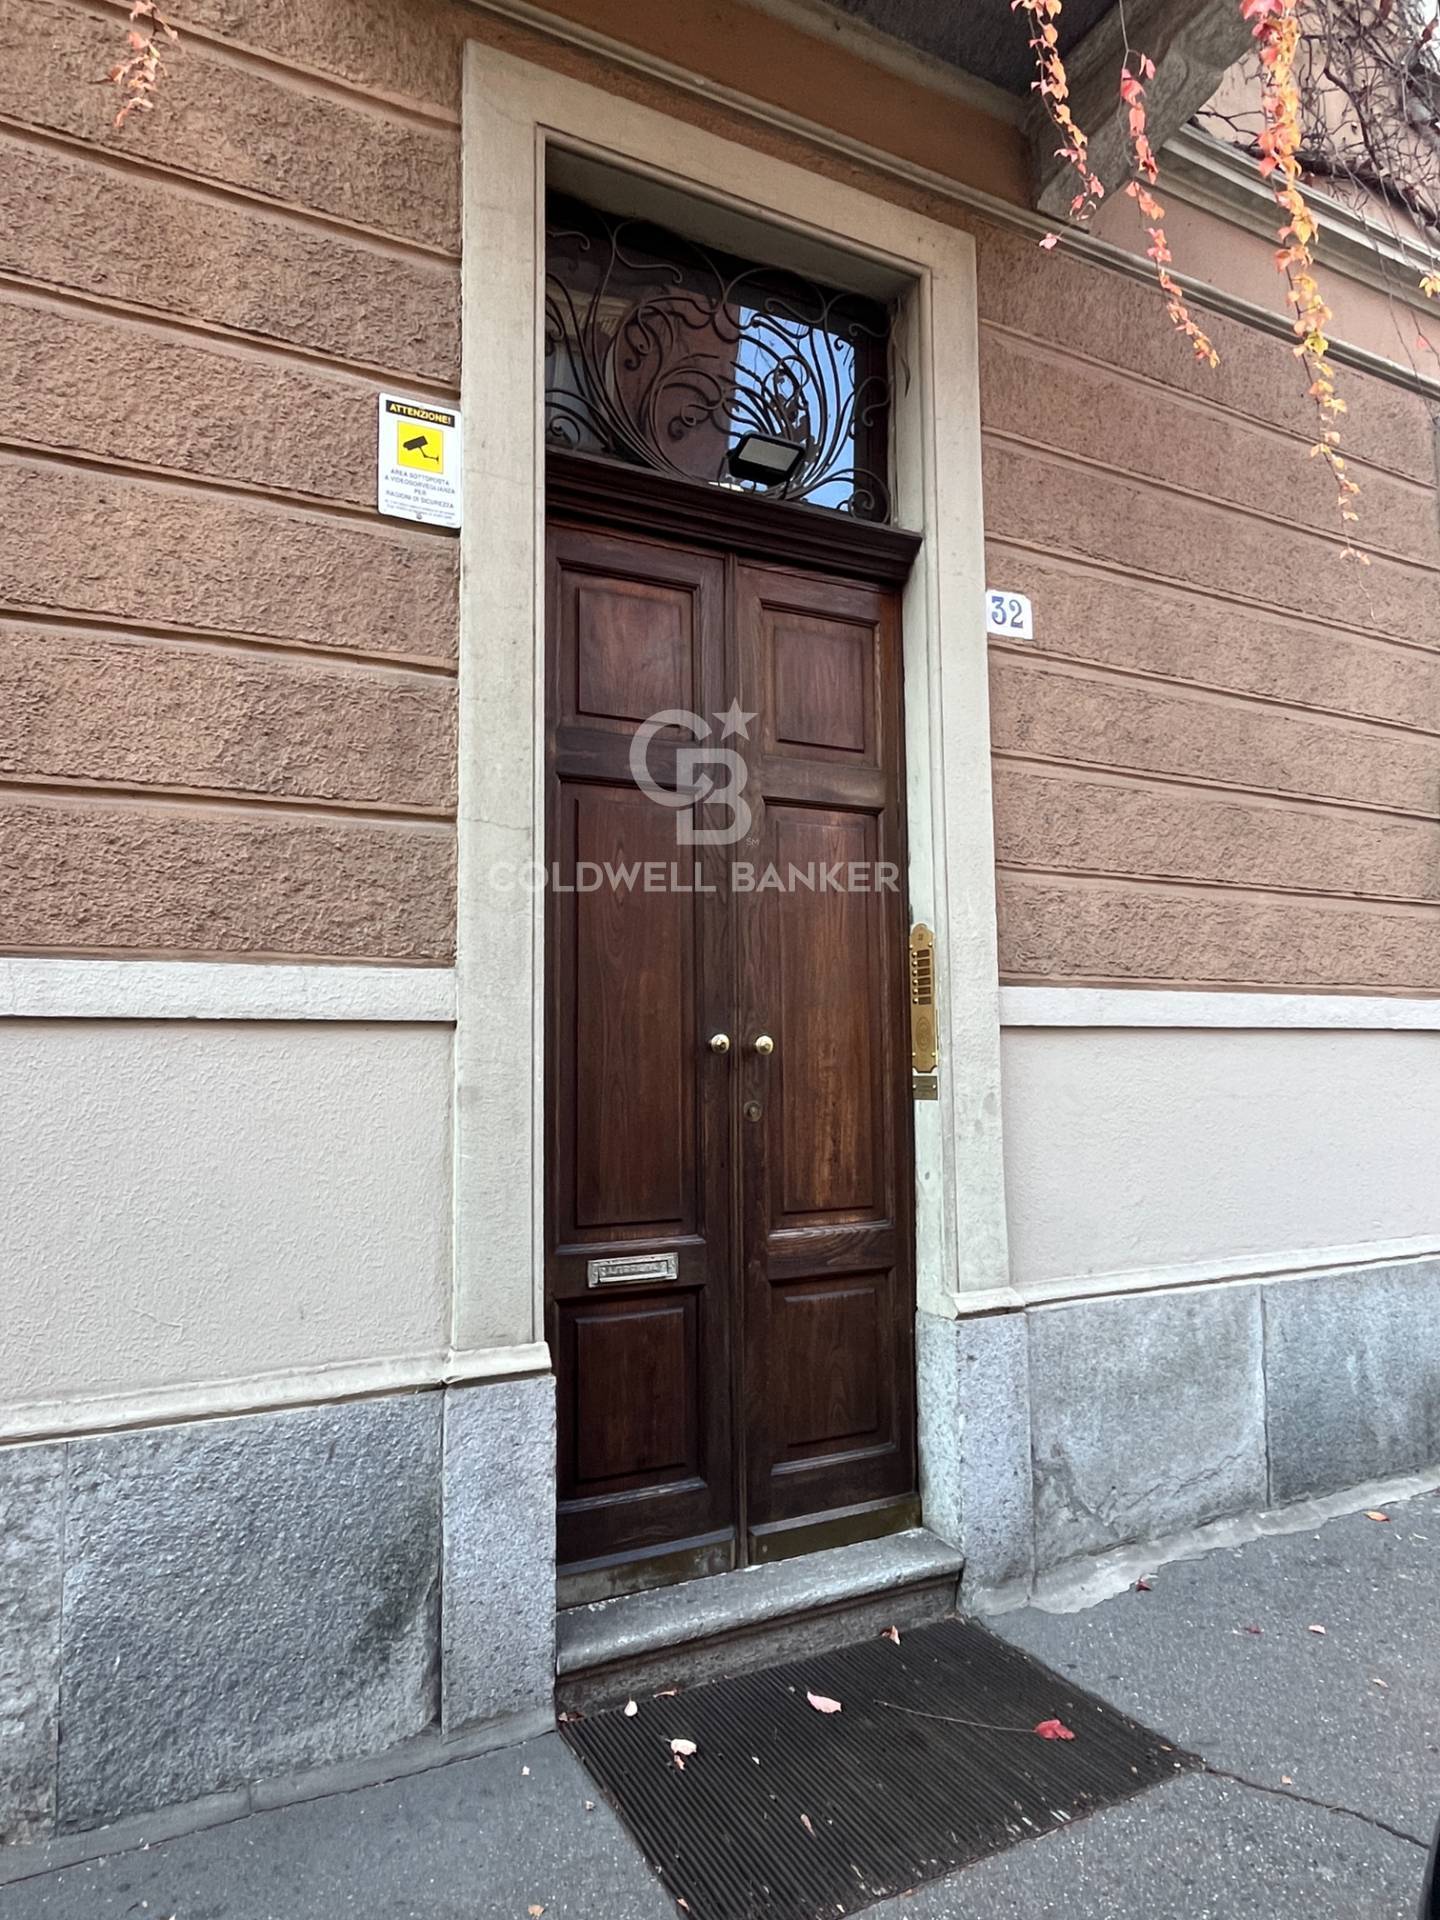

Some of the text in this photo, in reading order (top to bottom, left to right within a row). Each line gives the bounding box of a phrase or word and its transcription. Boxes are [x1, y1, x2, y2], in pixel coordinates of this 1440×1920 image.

[389, 402, 452, 425] ATTENZIONE!
[390, 468, 408, 476] AREA
[385, 490, 412, 500] RAGIONI
[420, 496, 454, 509] SICUREZZA
[991, 595, 1024, 629] 32
